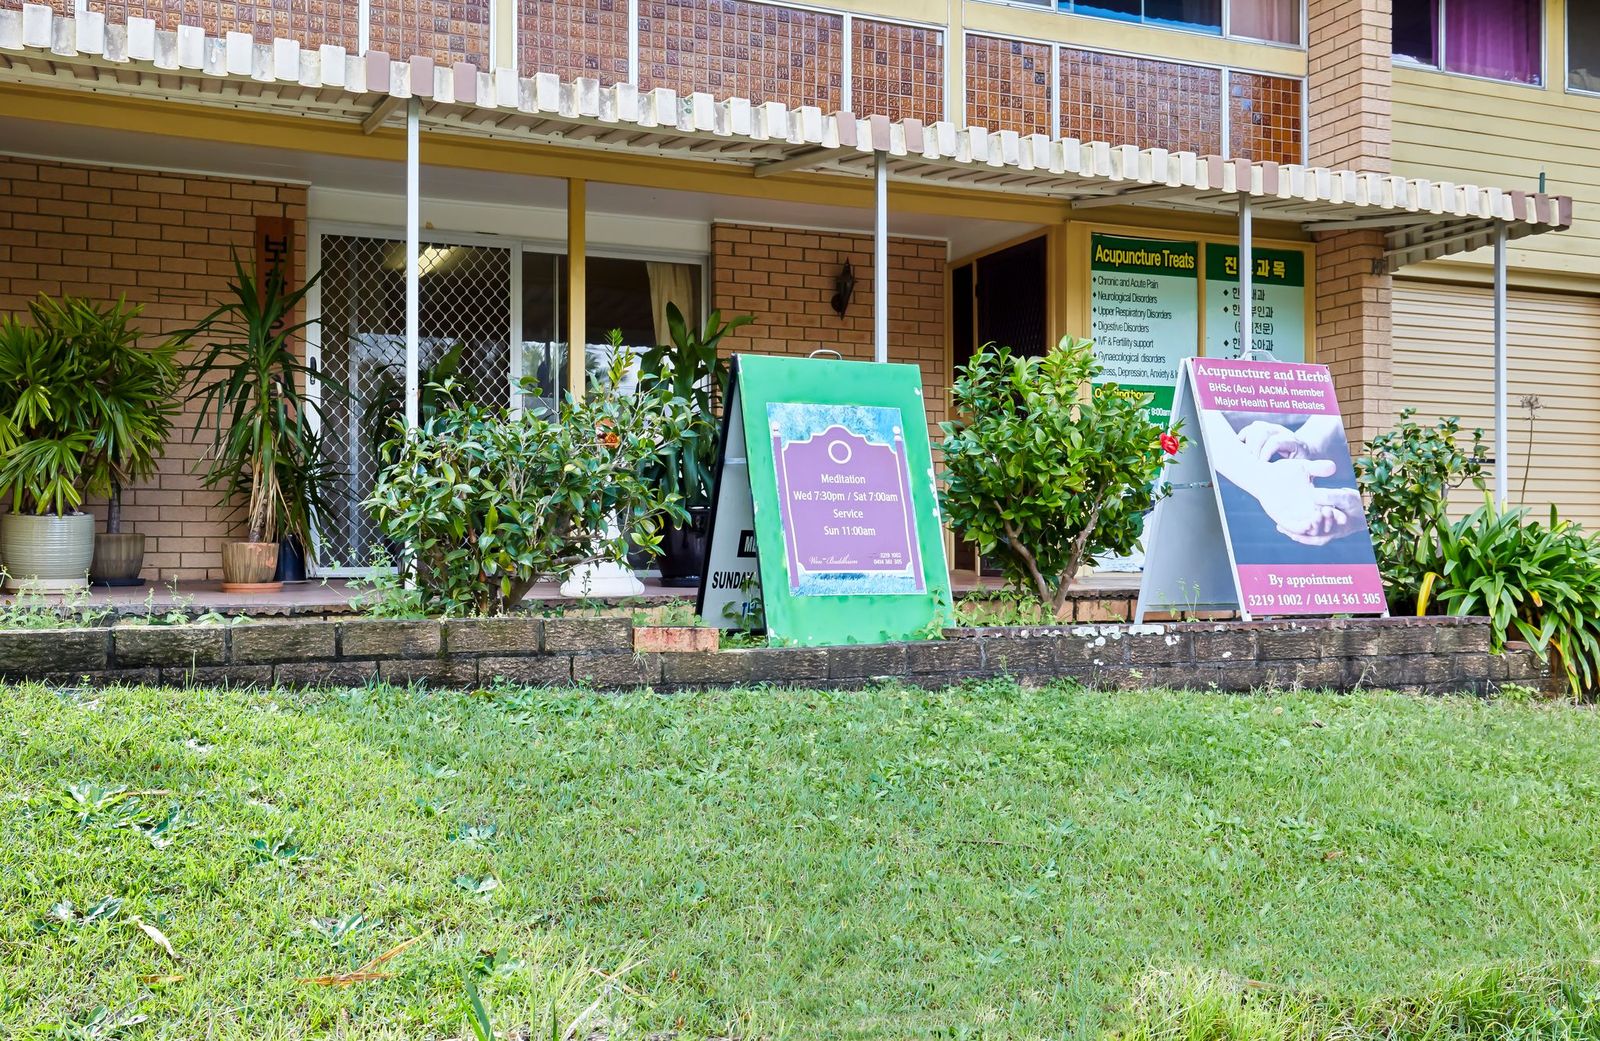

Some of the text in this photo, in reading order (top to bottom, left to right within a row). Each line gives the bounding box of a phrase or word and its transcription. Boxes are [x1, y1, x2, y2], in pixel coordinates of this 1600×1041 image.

[1095, 244, 1195, 269] Acupuncture Treats
[1225, 256, 1286, 278] 진과목
[1098, 276, 1158, 289] Chronic and Acute Pain
[1098, 291, 1158, 304] Neurological Disorders
[1098, 306, 1172, 320] Upper Respiratory Disorders
[1098, 321, 1150, 333] Digestive Disorders
[1098, 336, 1154, 349] IVF & Fertility support
[1098, 351, 1166, 364] Gynaecological disorders
[1118, 366, 1150, 378] Depression,
[1150, 369, 1169, 380] Anxiety
[1170, 370, 1174, 379] &
[1197, 364, 1330, 383] Acupuncture and Herbs
[1208, 382, 1324, 398] BHSc (Acu) AACMA member
[1214, 396, 1325, 410] Major Health Fund Rebates
[821, 474, 866, 484] Meditation
[793, 491, 898, 502] Wed 7:30pm / Sat 7:00am
[833, 509, 864, 518] Service
[824, 526, 876, 536] Sun 11:00am
[1268, 574, 1354, 588] By appointment
[1248, 593, 1381, 606] 3219 1002 / 0414 361 305
